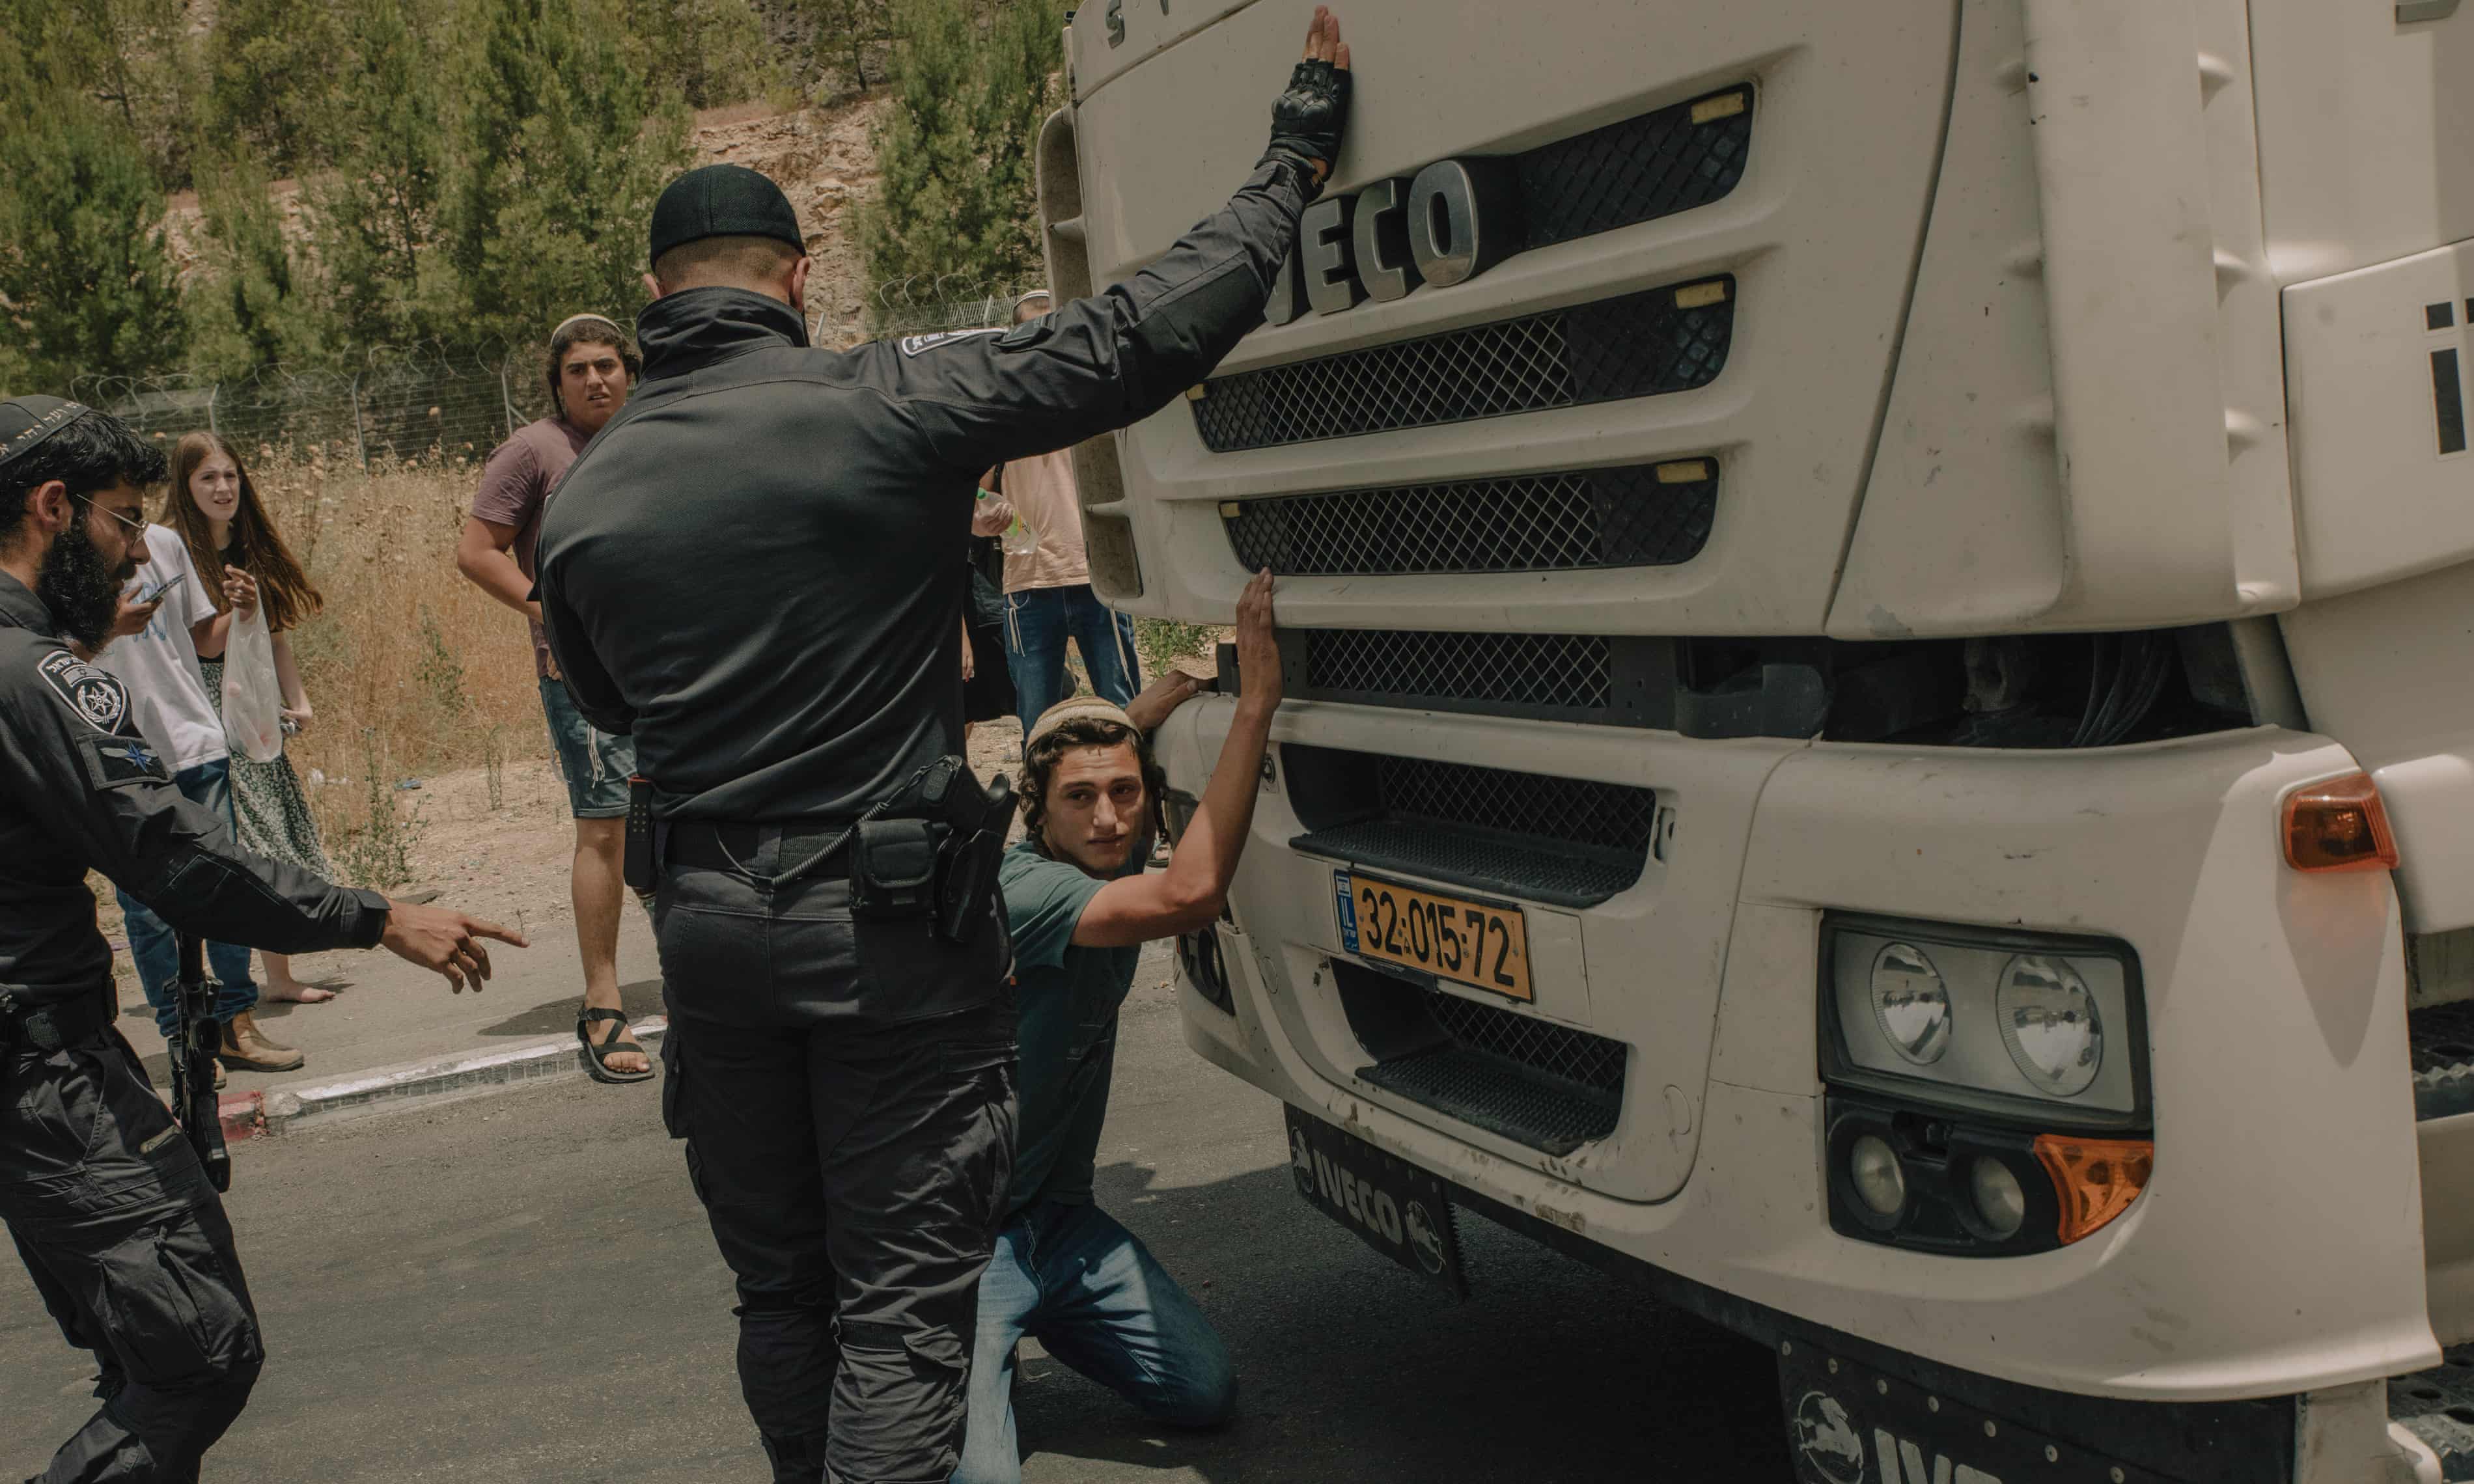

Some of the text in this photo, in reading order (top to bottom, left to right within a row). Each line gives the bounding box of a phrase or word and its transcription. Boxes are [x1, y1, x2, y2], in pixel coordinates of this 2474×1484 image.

[1263, 159, 1479, 327] ECO
[1313, 1147, 1403, 1245] IVECO
[1874, 1427, 2003, 1484] IV
